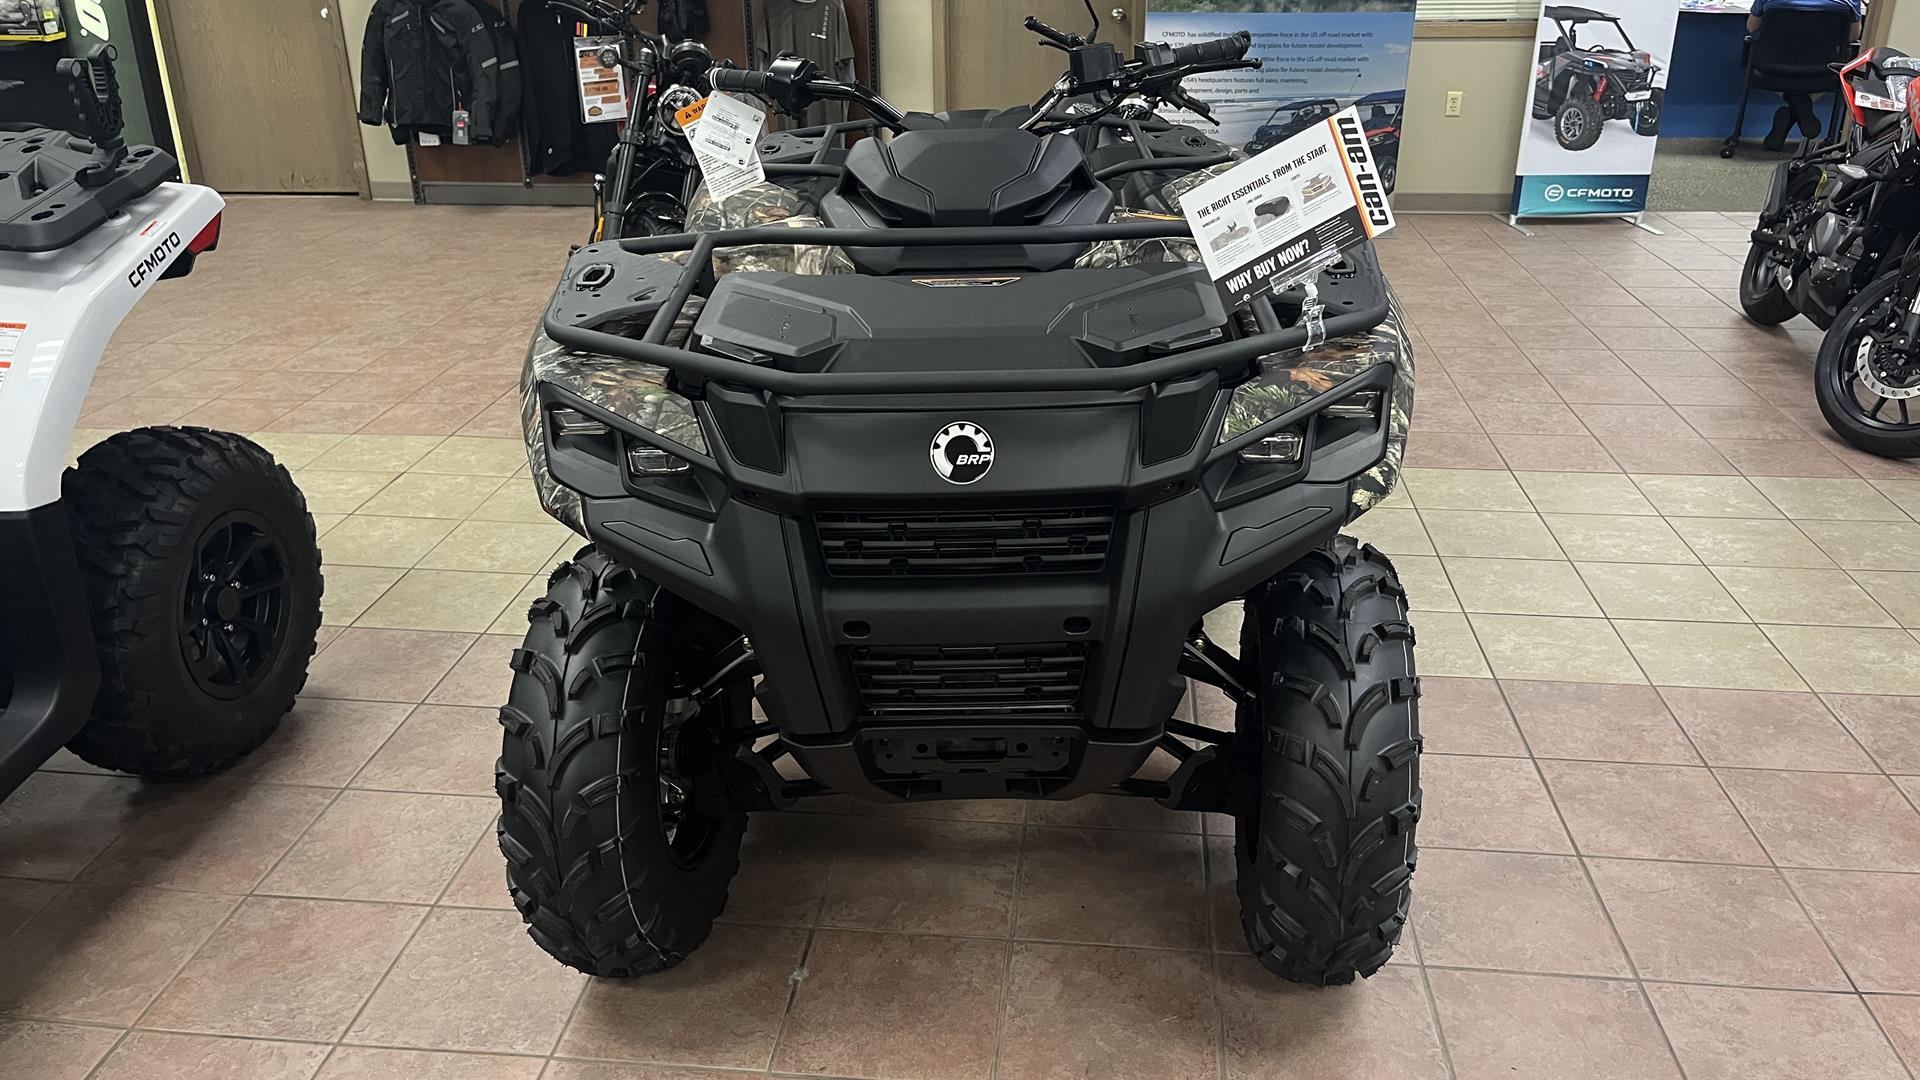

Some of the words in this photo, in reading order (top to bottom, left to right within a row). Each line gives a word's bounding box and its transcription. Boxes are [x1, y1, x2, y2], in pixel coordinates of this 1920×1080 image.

[1197, 204, 1211, 219] THE
[1211, 195, 1231, 212] RIGHT
[1273, 163, 1292, 179] FROM
[1292, 155, 1306, 168] THE
[1567, 188, 1634, 198] CFMOTO
[128, 232, 180, 288] CFMOTO
[1226, 270, 1252, 294] WHY
[1253, 257, 1276, 280] BUY
[1277, 239, 1310, 267] NOW?
[956, 454, 990, 465] BRP
